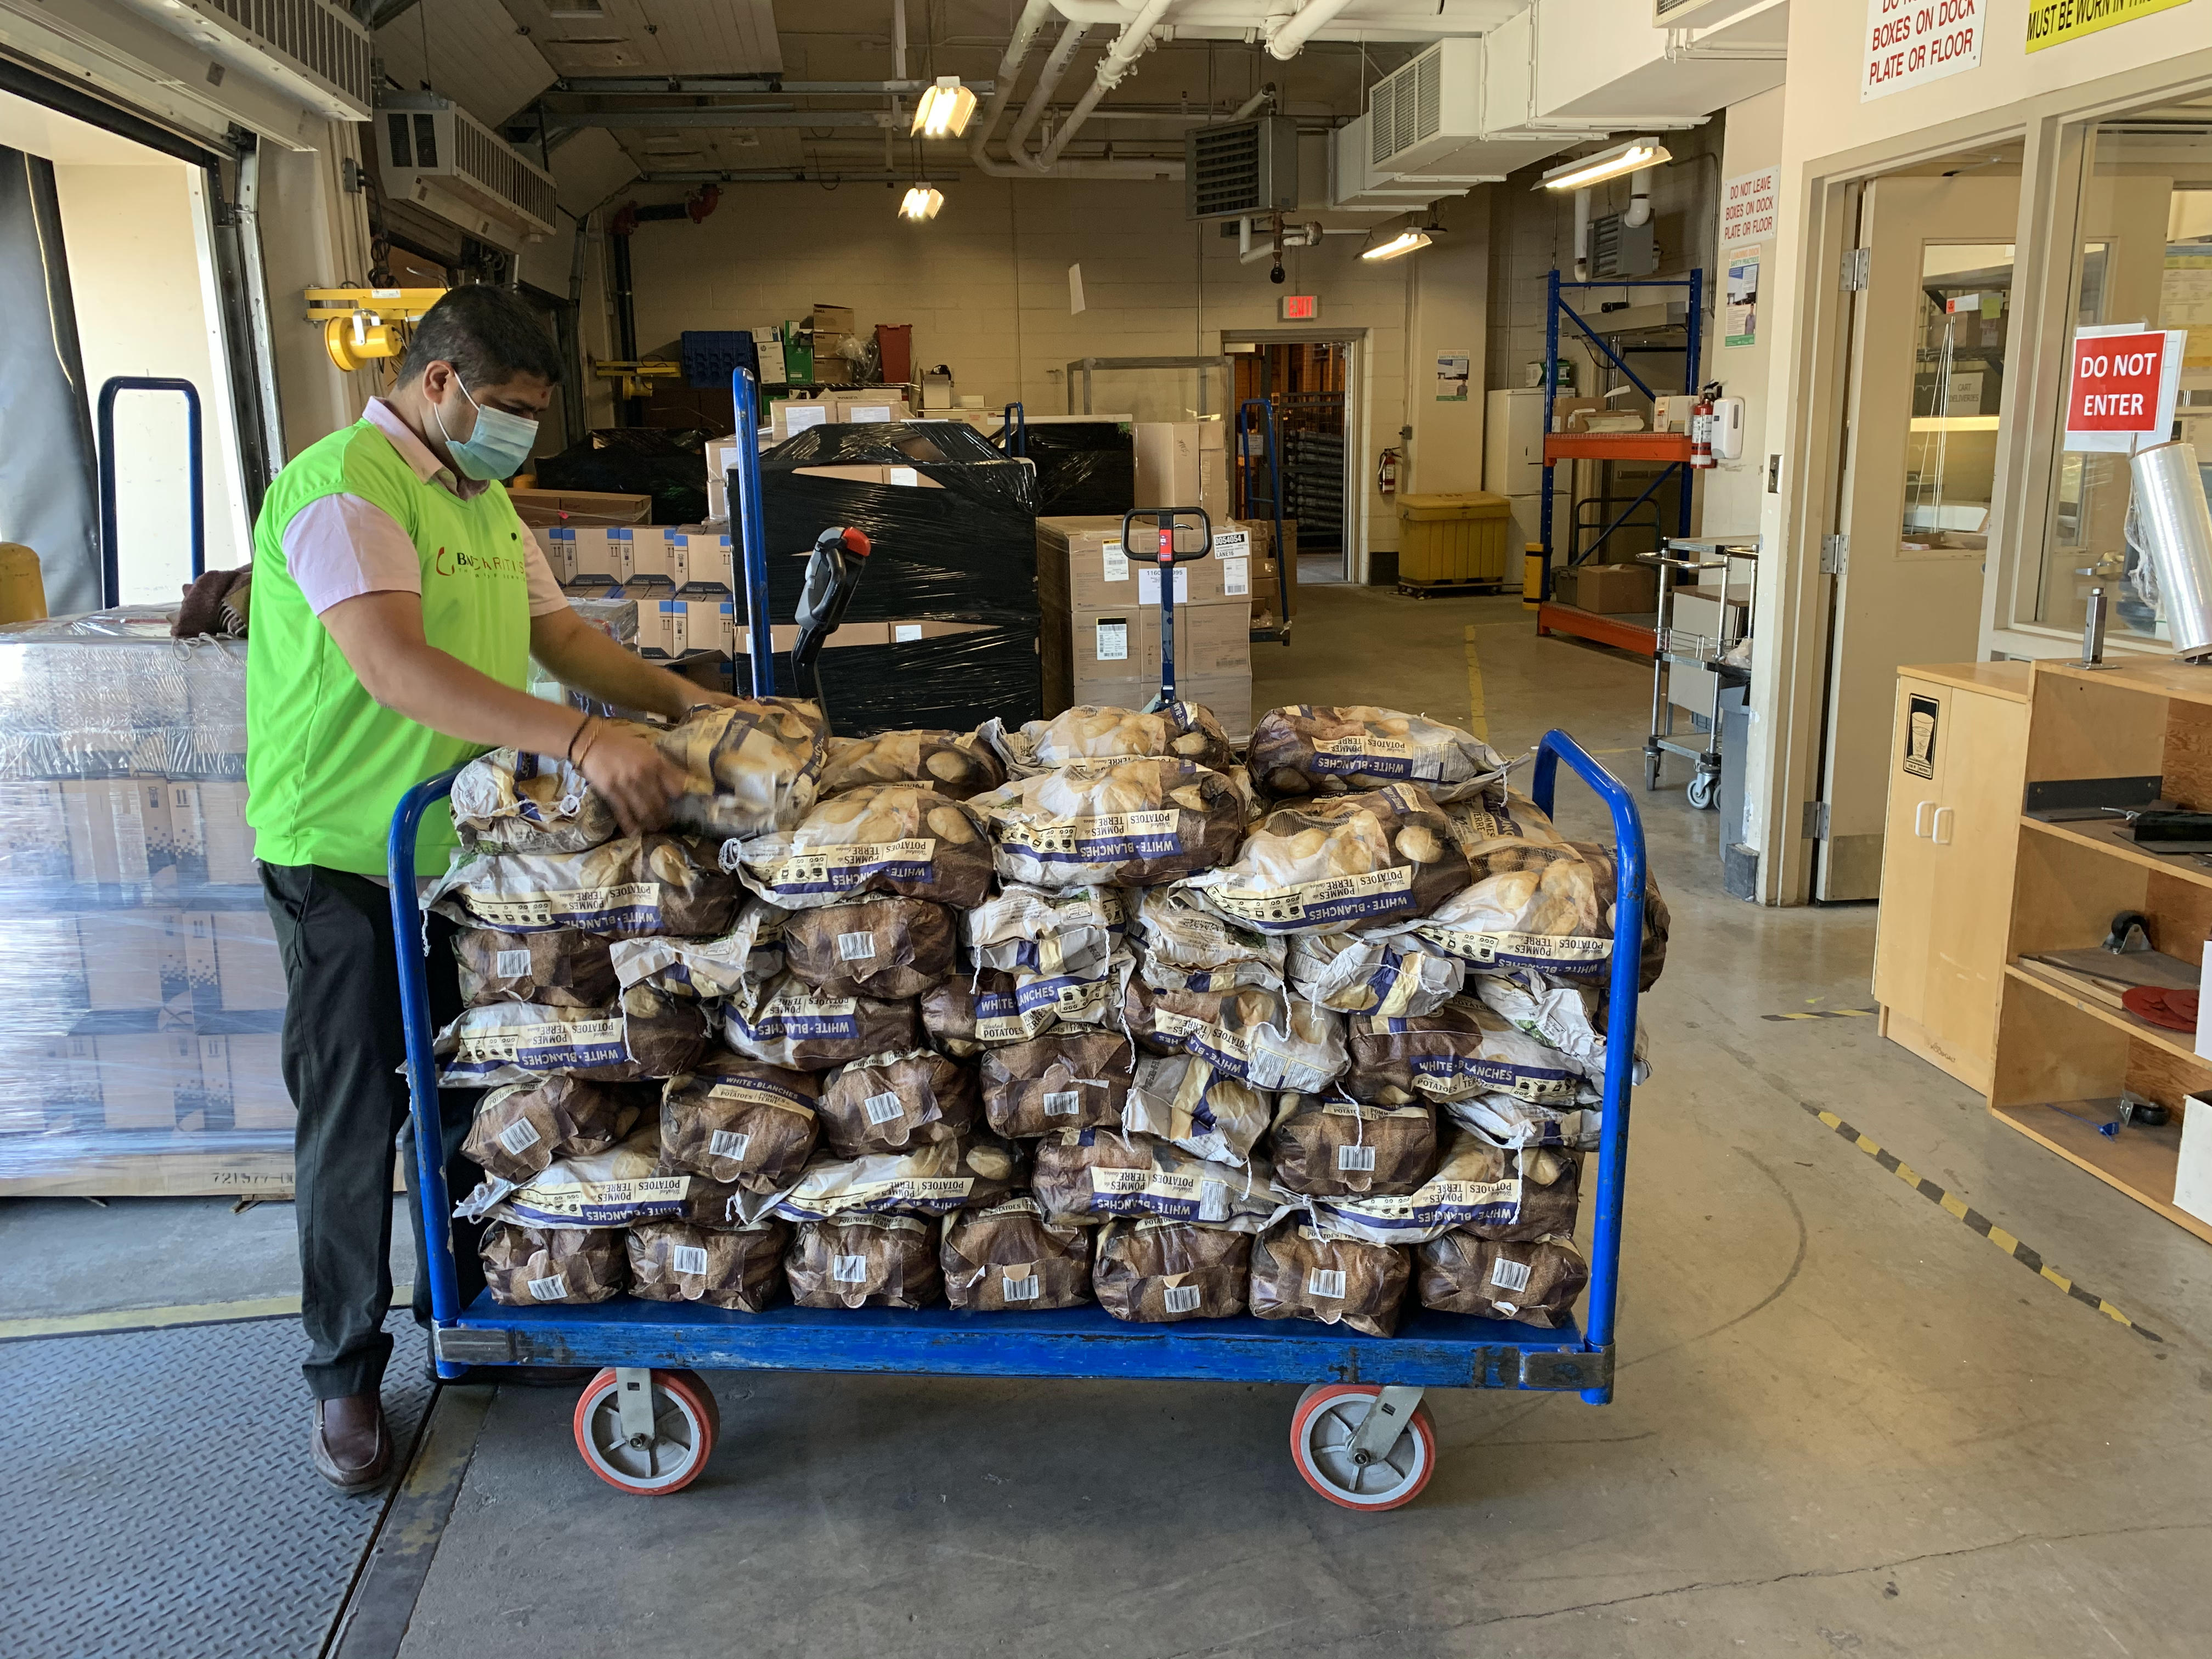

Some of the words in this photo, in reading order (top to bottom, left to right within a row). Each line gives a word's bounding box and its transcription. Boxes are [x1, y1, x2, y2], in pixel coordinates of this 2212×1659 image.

[1872, 15, 1911, 51] BOXES
[1916, 6, 1934, 35] ON
[1939, 0, 1975, 27] DOCK
[2027, 4, 2057, 42] MUST
[2058, 0, 2073, 31] BE
[2076, 0, 2109, 25] WORN
[1869, 52, 1904, 85] PLATE
[1909, 44, 1926, 72] OR
[1931, 28, 1973, 65] FLOOR
[1730, 186, 1739, 200] DO
[1740, 181, 1752, 198] NOT
[1753, 176, 1771, 194] LEAVE
[1726, 204, 1743, 221] BOXES
[1746, 201, 1754, 214] ON
[1756, 195, 1774, 213] DOCK
[1725, 223, 1741, 240] PLATE
[1743, 221, 1751, 236] OR
[1753, 216, 1772, 234] FLOOR
[1289, 297, 1312, 317] EXIT
[2081, 356, 2108, 377] DO
[2113, 353, 2157, 376] NOT
[2084, 393, 2143, 416] ENTER
[1215, 535, 1242, 545] 0054054
[1368, 738, 1405, 748] POTATOES
[1099, 816, 1124, 825] TERRE
[1131, 814, 1170, 823] POTATOES
[1092, 825, 1124, 836] POMMES
[853, 847, 879, 855] TERRE
[887, 842, 926, 852] POTATOES
[1361, 870, 1402, 885] POTATOES
[1327, 878, 1355, 890] TERRE
[577, 891, 603, 900] TERRE
[610, 886, 651, 898] POTATOES
[1320, 888, 1355, 900] POMMES
[569, 900, 603, 910] POMMES
[1525, 936, 1552, 946] TERRE
[1559, 939, 1604, 950] POTATOES
[1515, 944, 1551, 956] POMMES
[540, 1024, 566, 1035] TERRE
[572, 1023, 613, 1033] POTATOES
[984, 1028, 1024, 1037] POTATOES
[533, 1034, 567, 1045] POMMES
[1212, 1028, 1249, 1049] POTATOES
[720, 1091, 752, 1099] POTATOES
[1120, 1172, 1146, 1181] TERRE
[1153, 1174, 1193, 1187] POTATOES
[606, 1183, 631, 1192] TERRE
[639, 1180, 680, 1190] POTATOES
[922, 1181, 963, 1189] POTATOES
[1111, 1181, 1145, 1190] POMMES
[597, 1192, 631, 1202] POMMES
